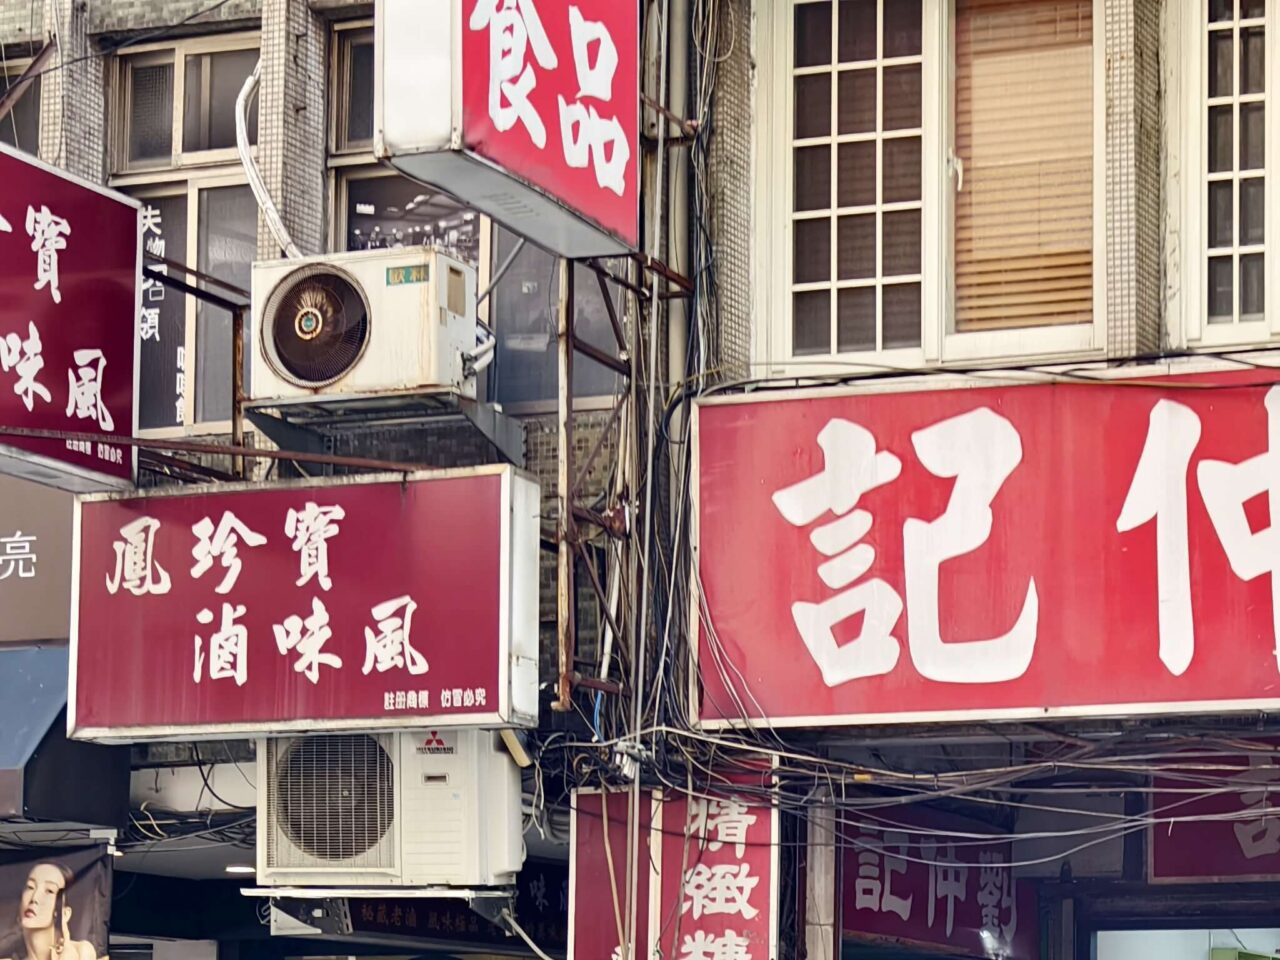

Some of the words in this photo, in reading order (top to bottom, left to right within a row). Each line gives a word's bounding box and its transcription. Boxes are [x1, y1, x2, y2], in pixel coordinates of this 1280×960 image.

[105, 501, 346, 597] 鳳珍寶
[192, 595, 430, 687] 滷味風
